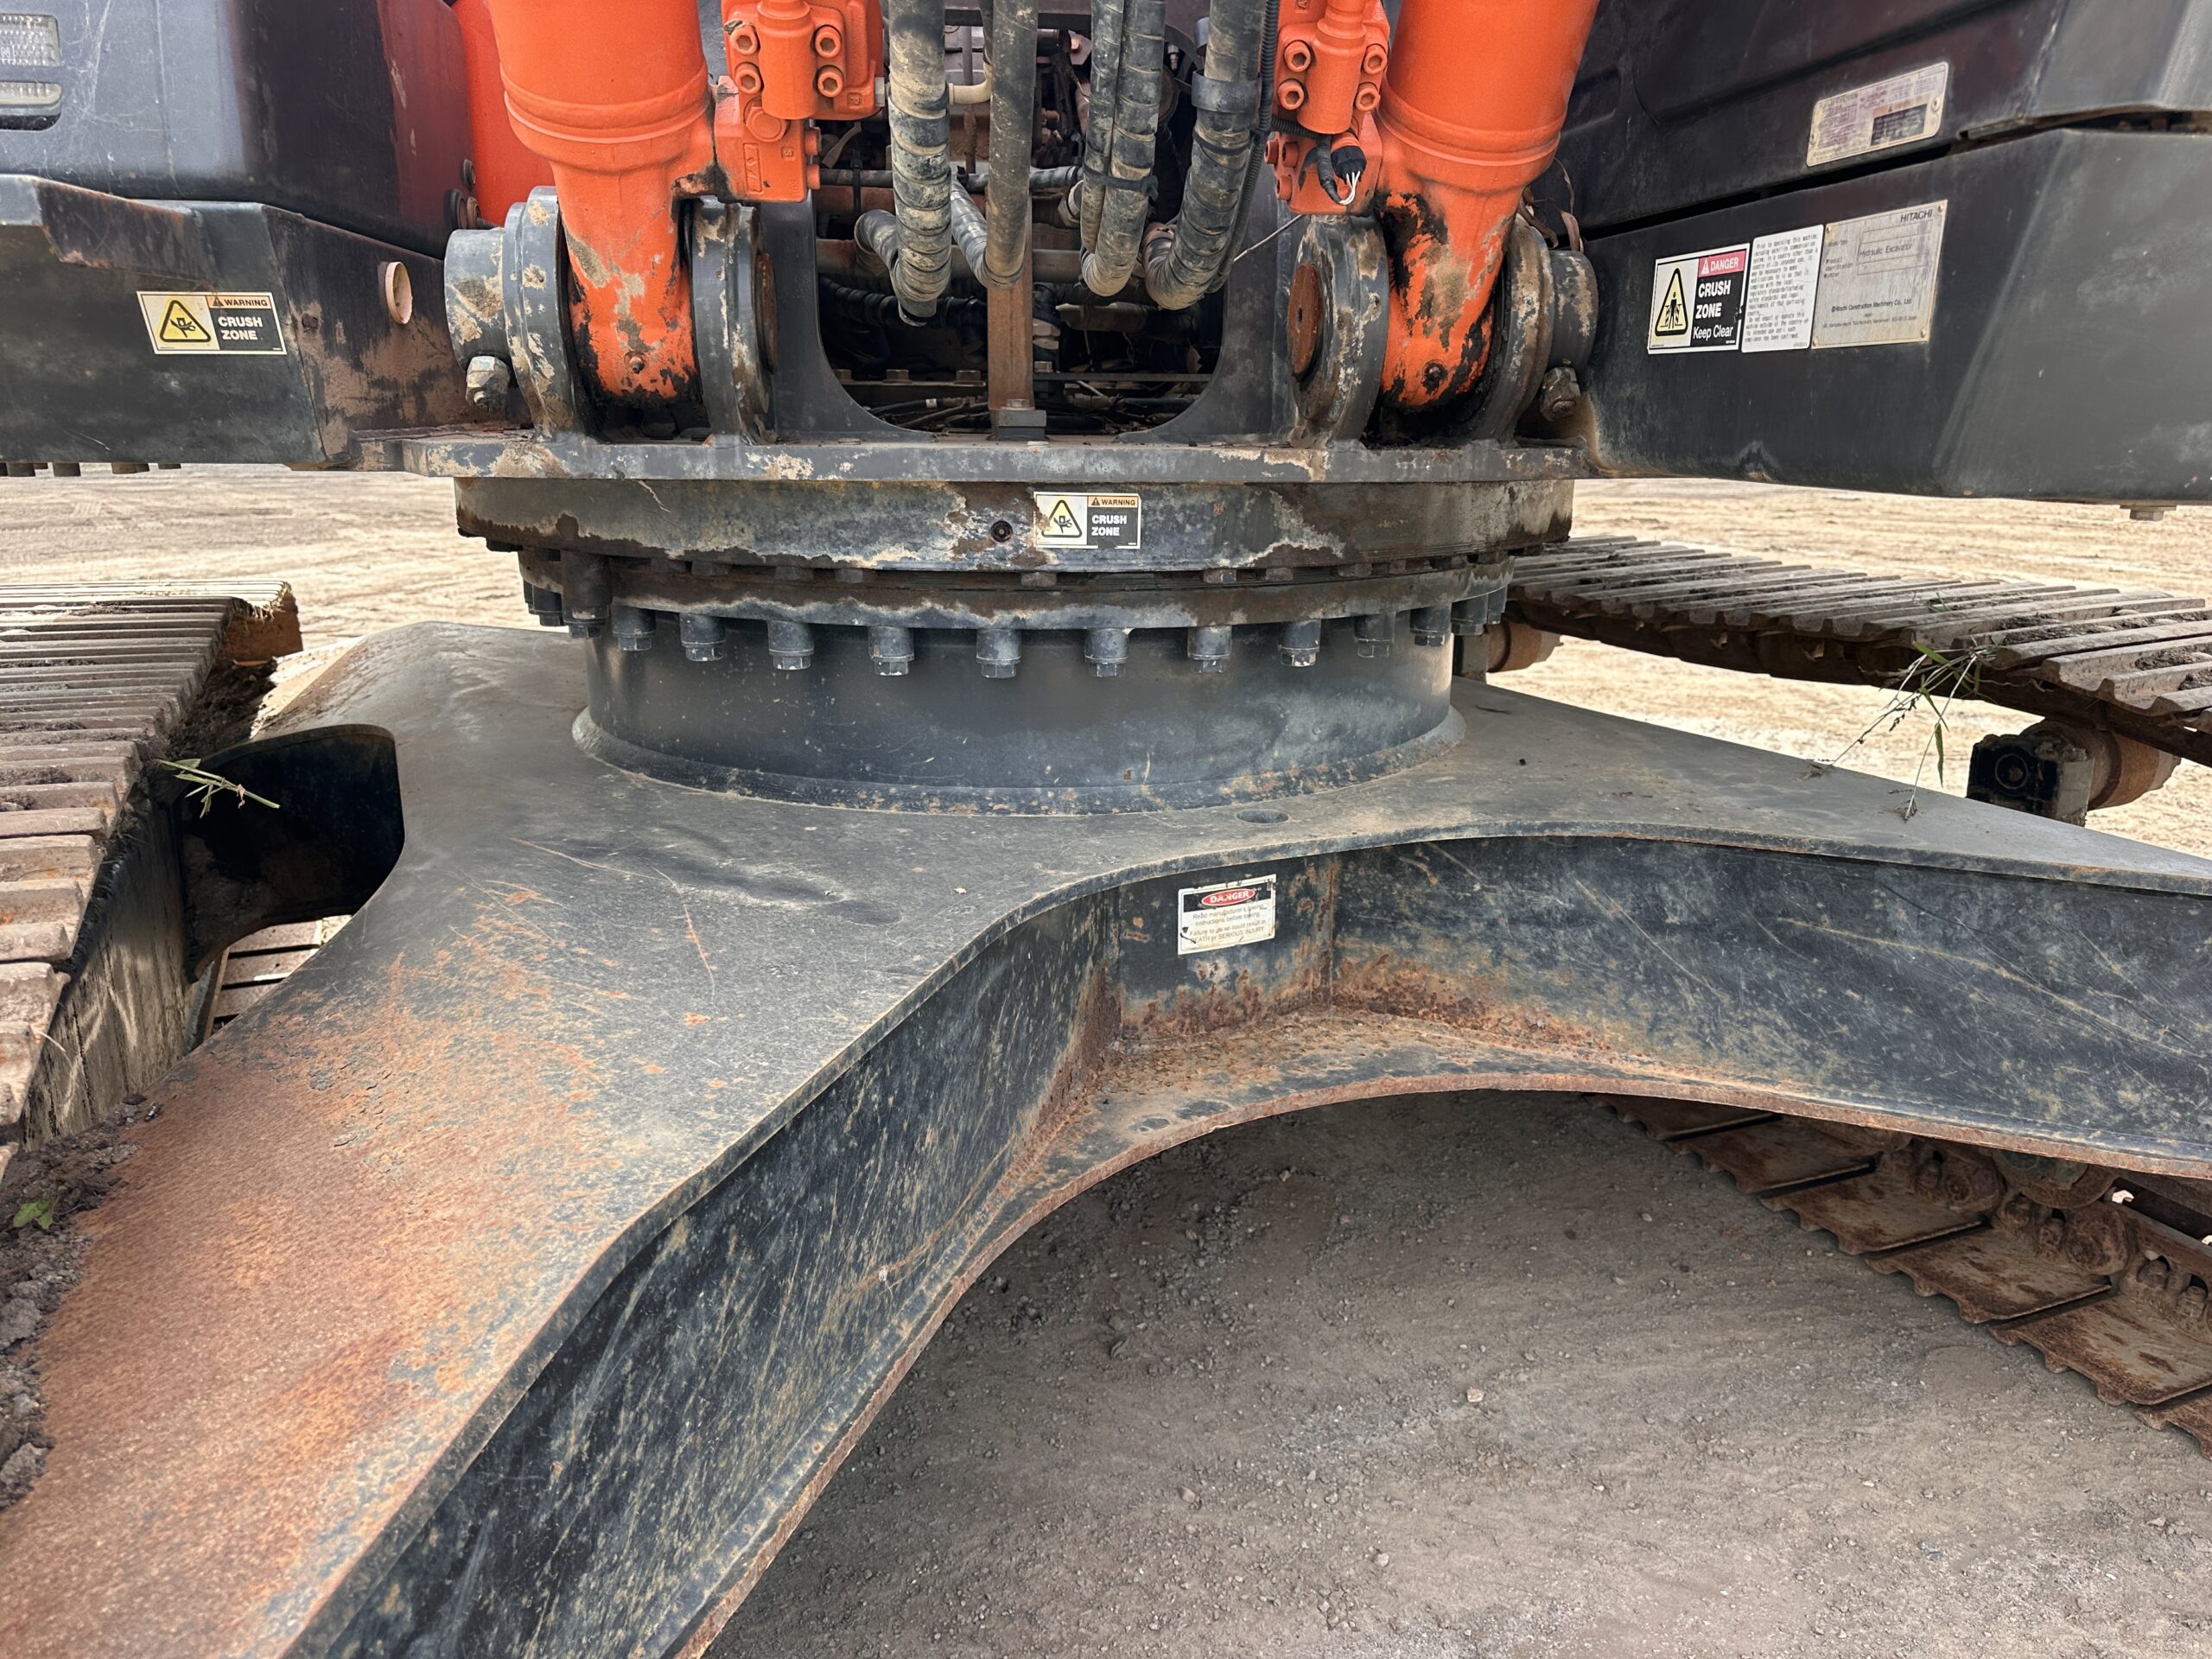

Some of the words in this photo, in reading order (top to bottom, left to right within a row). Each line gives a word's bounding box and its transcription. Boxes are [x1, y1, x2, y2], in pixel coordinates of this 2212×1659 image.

[1900, 209, 1933, 223] HITACHI
[1710, 257, 1739, 272] DANGER
[1698, 279, 1732, 298] CRUSH
[1695, 302, 1722, 319] ZONE
[218, 316, 263, 327] CRUSH
[220, 330, 258, 340] ZONE
[1693, 326, 1712, 341] Keep
[1713, 324, 1733, 339] Clear
[1091, 514, 1127, 524] CRUSH
[1091, 526, 1120, 536] ZONE
[1210, 890, 1249, 903] DANGER
[1218, 930, 1243, 938] SERIOUS
